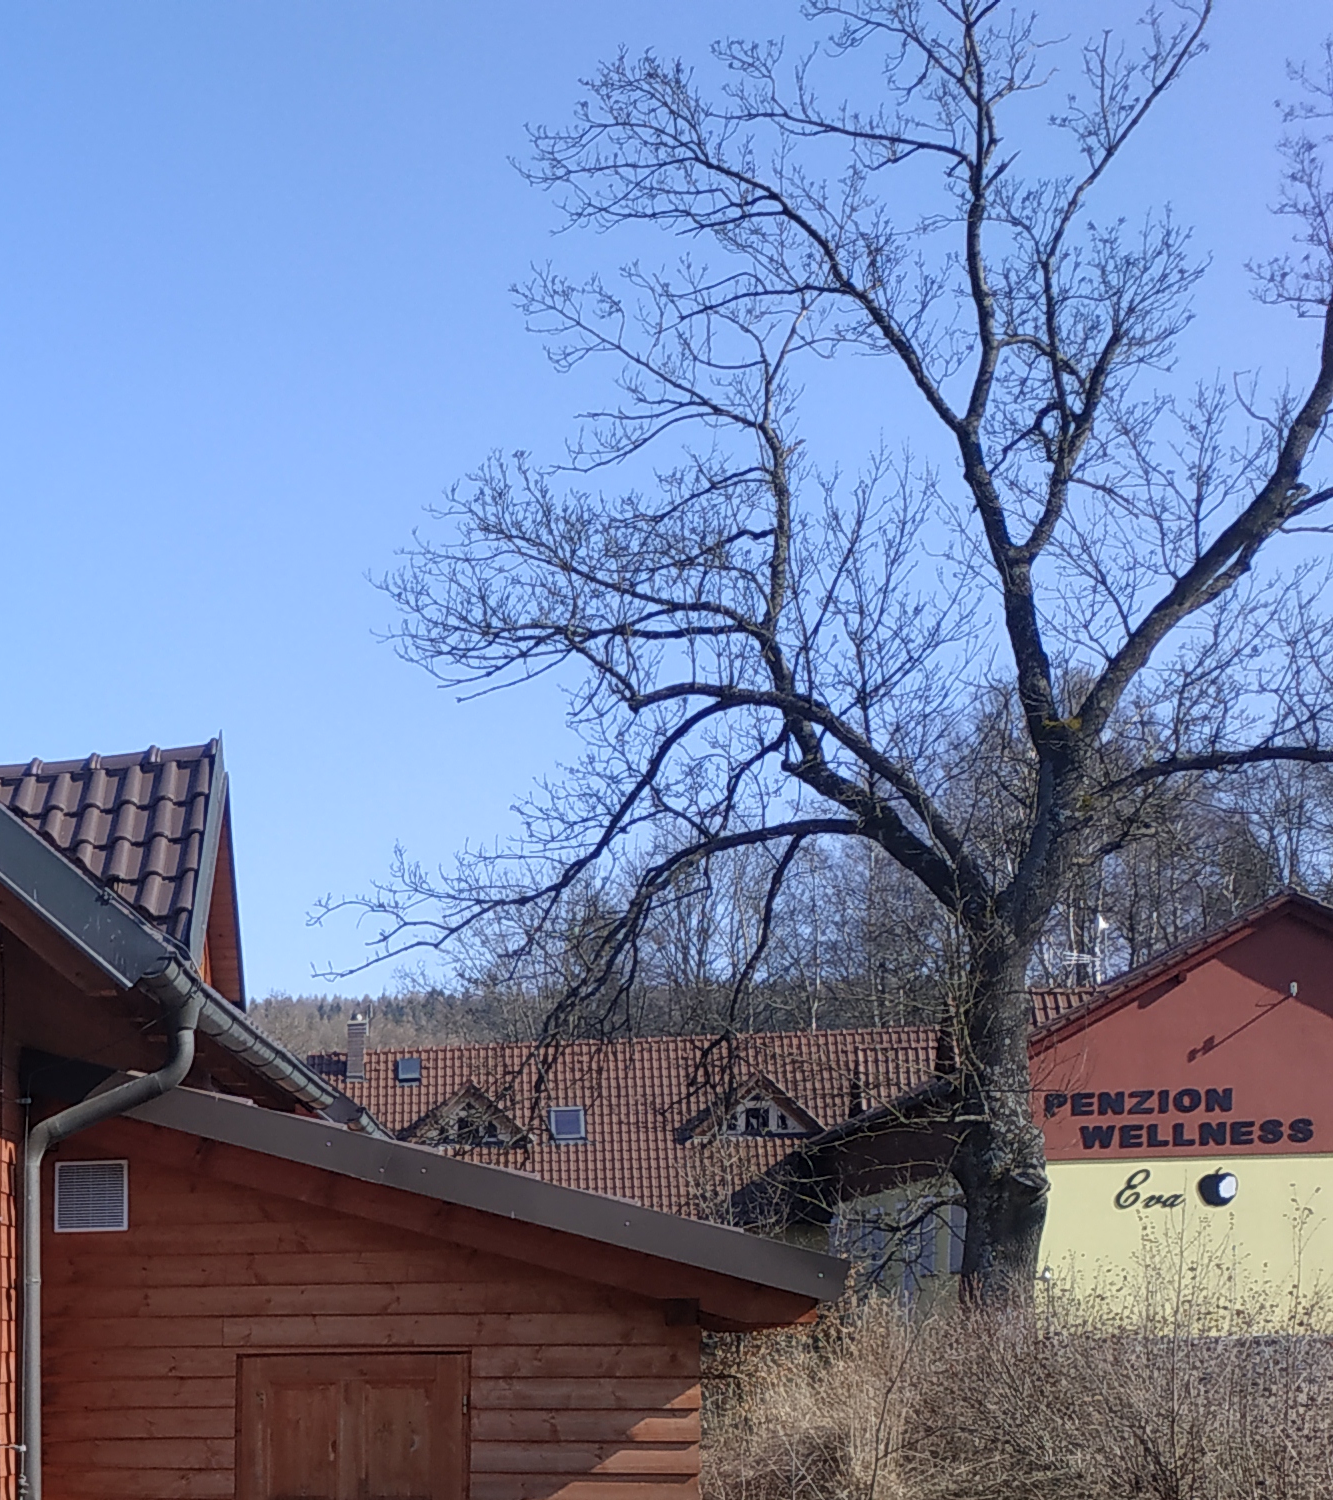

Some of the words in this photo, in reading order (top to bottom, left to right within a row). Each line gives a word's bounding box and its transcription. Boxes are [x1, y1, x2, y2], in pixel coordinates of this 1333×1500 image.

[1043, 1088, 1233, 1118] PENZION
[1079, 1118, 1314, 1149] WELLNESS
[1114, 1168, 1186, 1210] Eva
